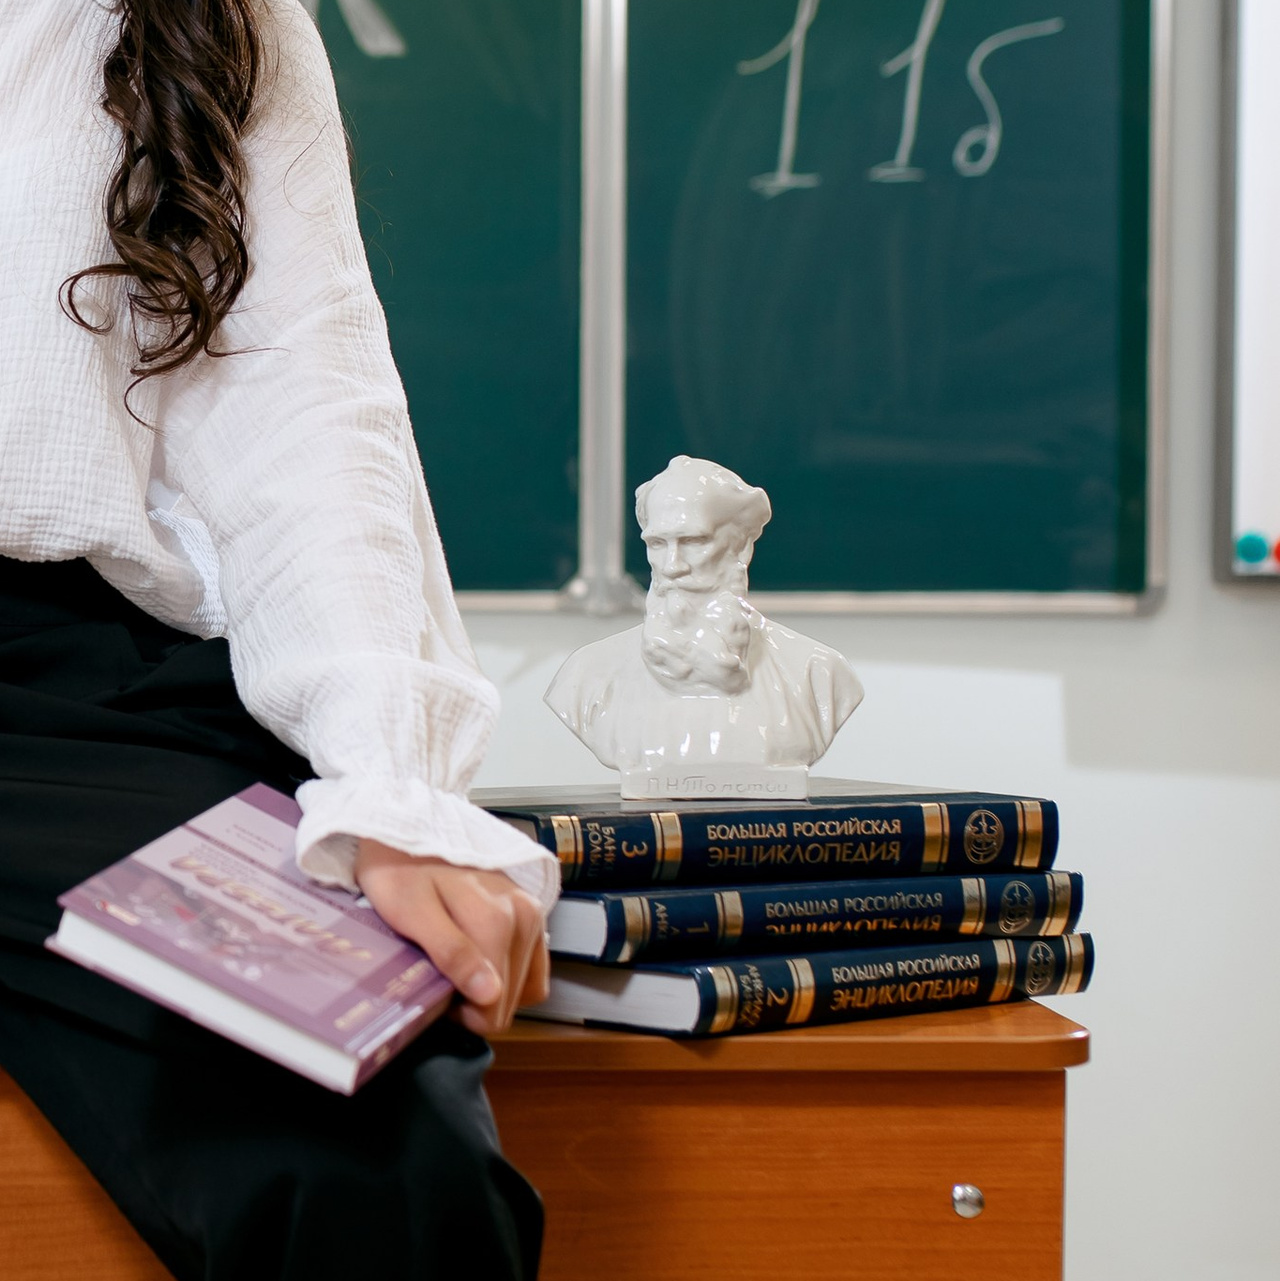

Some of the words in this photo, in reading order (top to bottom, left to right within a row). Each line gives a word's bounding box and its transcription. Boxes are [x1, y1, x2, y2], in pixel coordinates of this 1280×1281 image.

[706, 822, 788, 840] БОЛЬШАЯ
[792, 817, 902, 837] РОССИЙСКАЯ
[621, 841, 649, 858] 3
[707, 841, 902, 868] ЭНЦИКЛОПЕДИЯ
[765, 898, 839, 918] БОЛЬШАЯ
[843, 892, 943, 913] РОССИЙСКАЯ
[686, 921, 711, 934] 1
[831, 962, 895, 984] БОЛЬШАЯ
[896, 954, 981, 977] РОССИЙСКАЯ
[766, 987, 789, 1007] 2
[830, 976, 980, 1011] ЭНЦИКЛОПЕДИЯ
